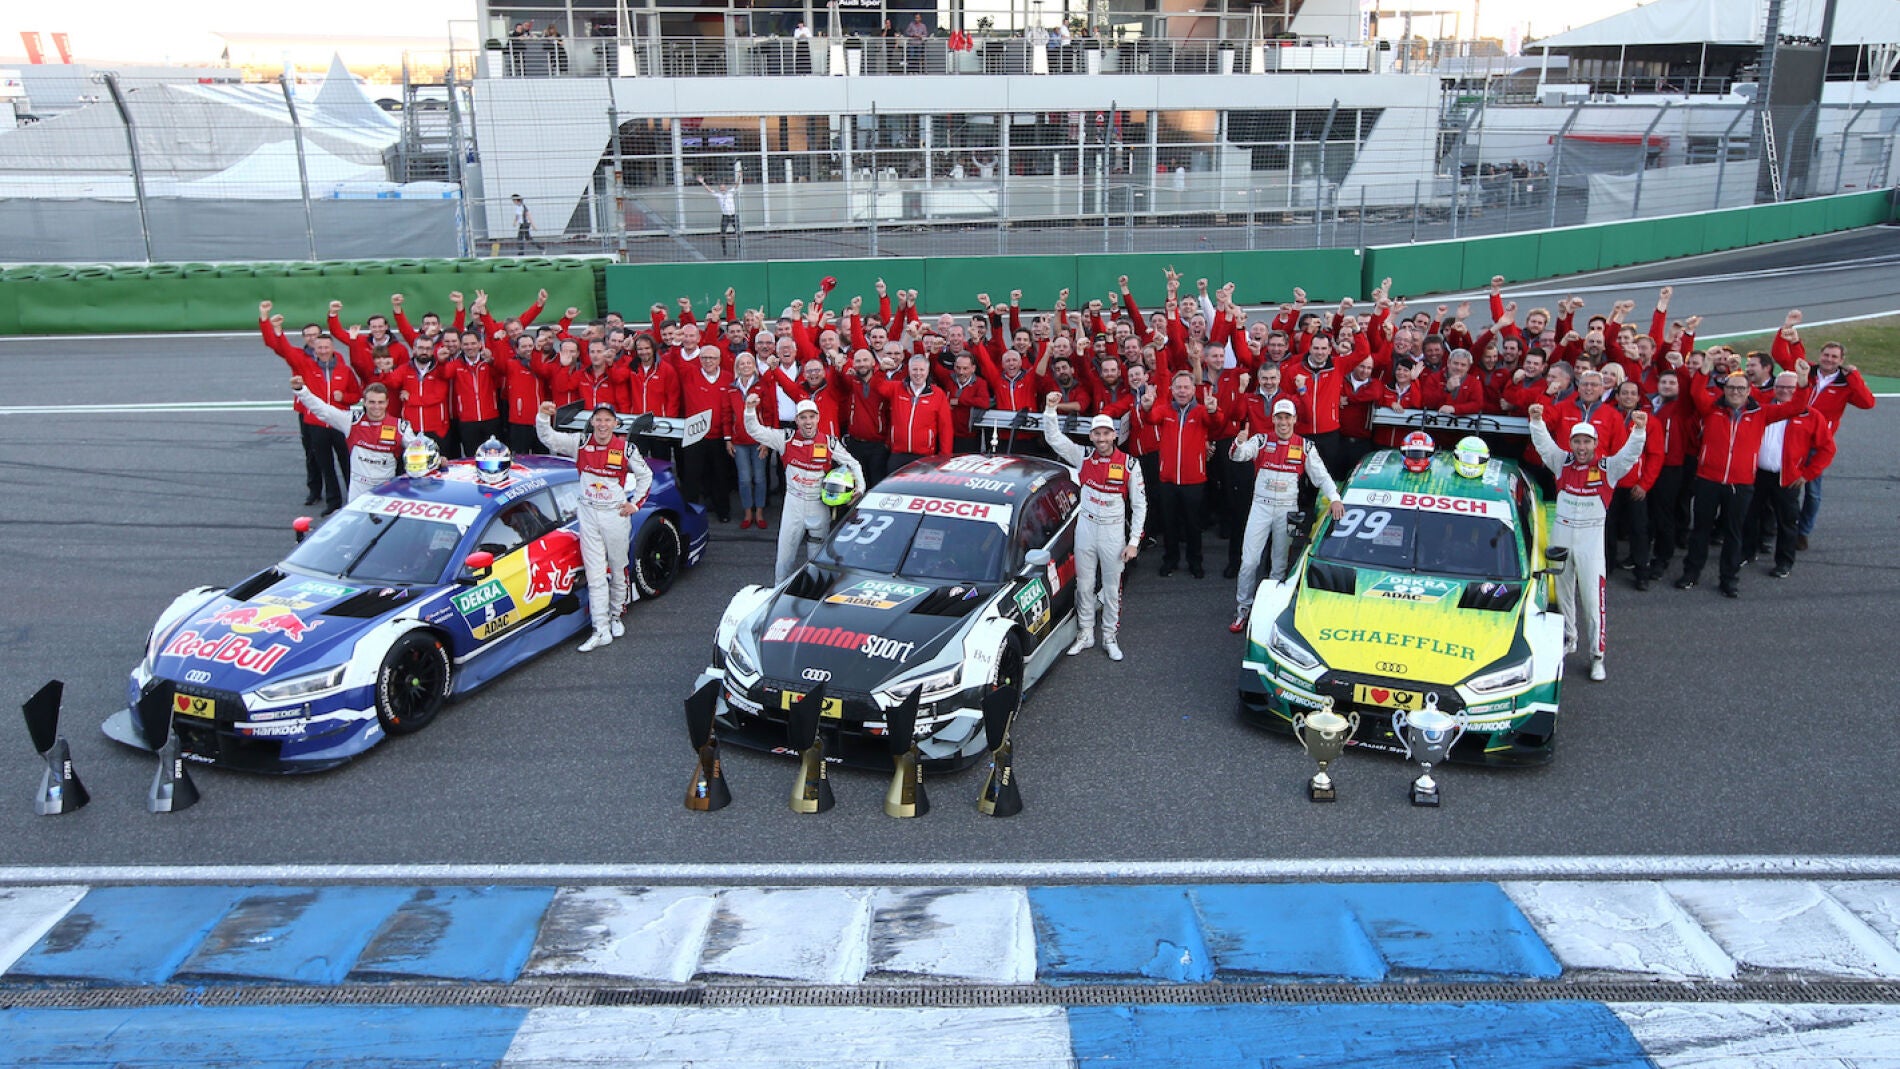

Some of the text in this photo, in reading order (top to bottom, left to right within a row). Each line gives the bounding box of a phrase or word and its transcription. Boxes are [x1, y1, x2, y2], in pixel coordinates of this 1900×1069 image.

[384, 500, 458, 520] BOSCH
[908, 498, 990, 518] BOSCH
[1400, 494, 1487, 514] BOSCH
[309, 514, 357, 543] 5
[835, 513, 894, 545] 33
[1331, 509, 1392, 539] 99
[298, 582, 345, 595] DEKRA
[861, 581, 916, 596] DEKRA
[1390, 576, 1448, 590] DEKRA
[461, 583, 501, 611] DEKRA
[844, 597, 881, 608] ADAC
[858, 590, 889, 601] 33
[1382, 591, 1422, 601] ADAC
[485, 603, 496, 622] 5
[484, 615, 509, 636] ADAC
[164, 631, 288, 673] Red Bull
[1319, 629, 1475, 661] SCHAEFFLER
[1362, 687, 1367, 702] I
[1001, 766, 1011, 786] DTM
